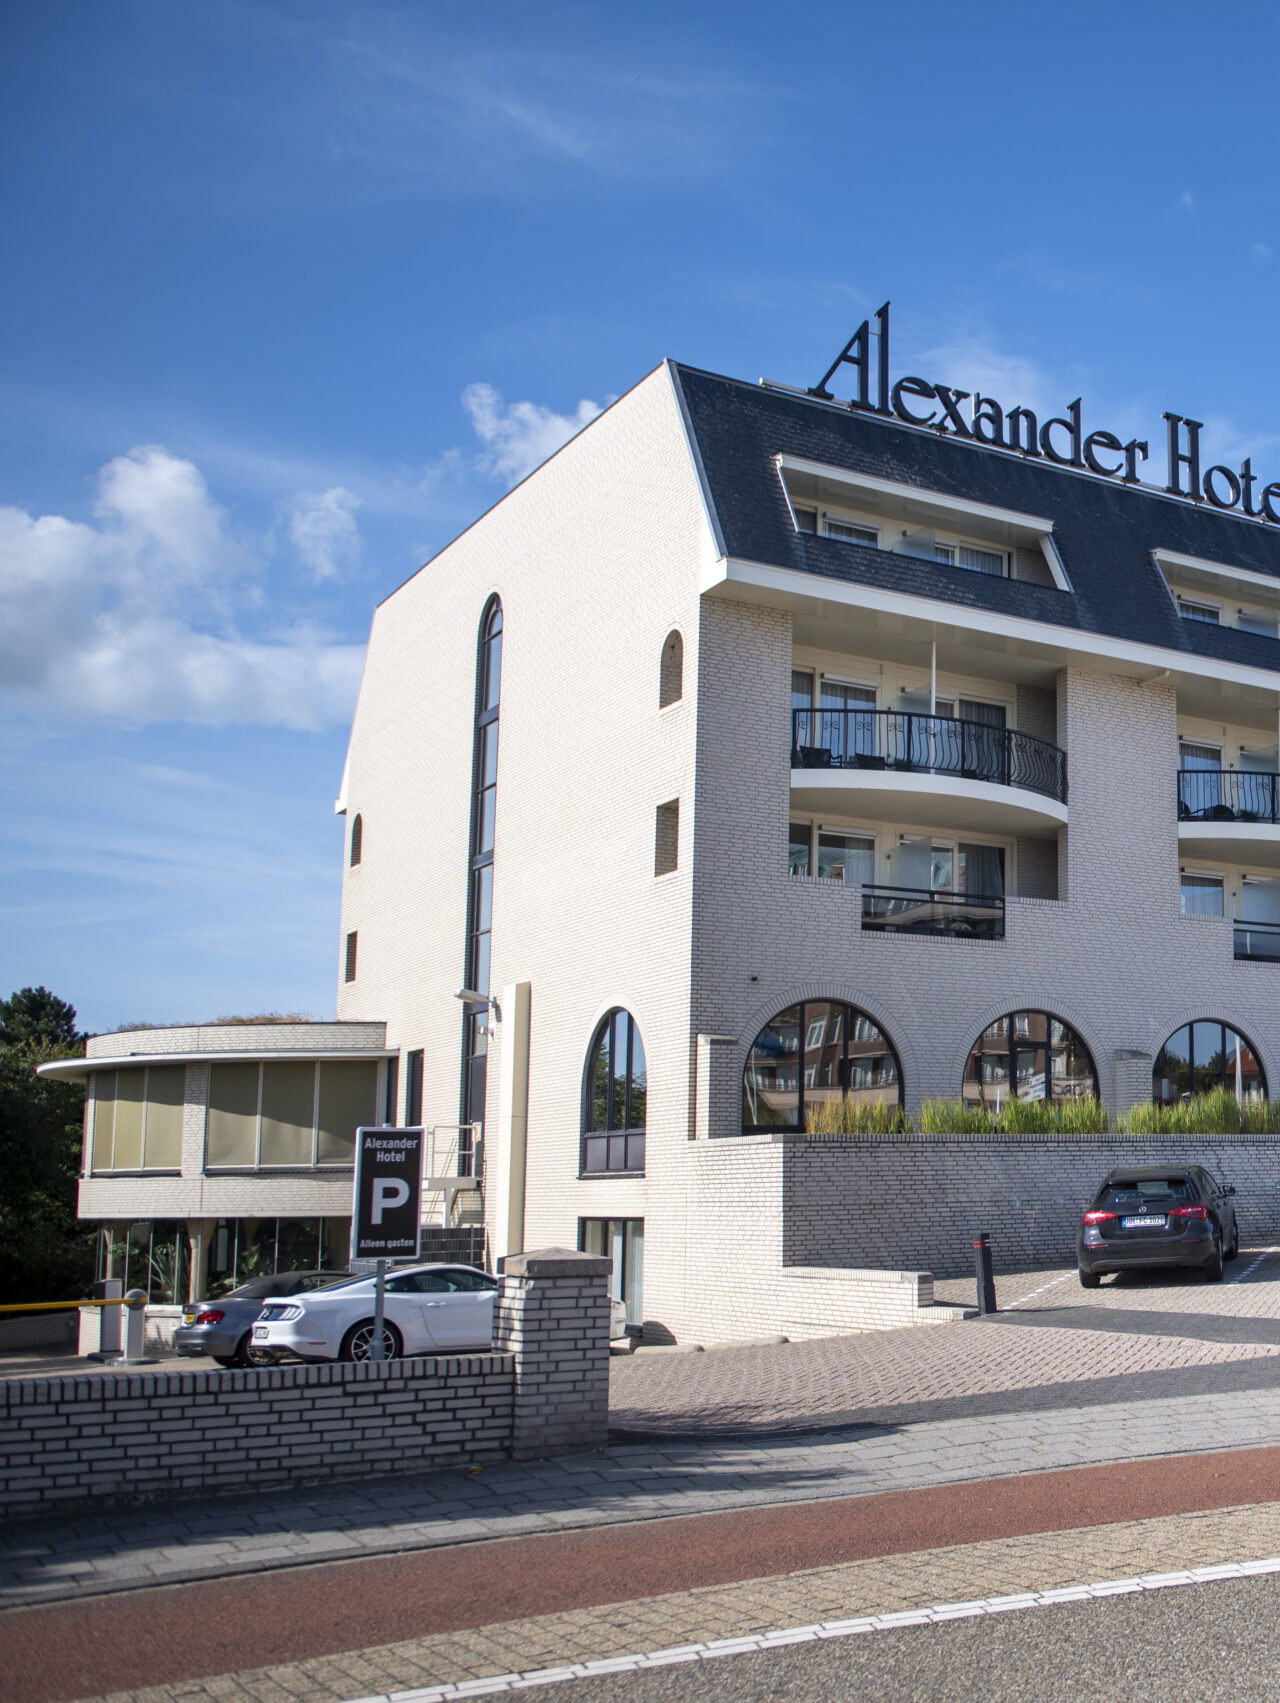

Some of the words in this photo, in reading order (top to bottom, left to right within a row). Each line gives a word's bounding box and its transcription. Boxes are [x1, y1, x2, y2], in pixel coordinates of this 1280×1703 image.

[806, 300, 1149, 483] Alexander
[364, 1137, 418, 1149] Alexander
[376, 1151, 406, 1162] Hotel
[371, 1177, 410, 1225] P
[360, 1239, 385, 1248] Alleen
[387, 1239, 414, 1249] gasten
